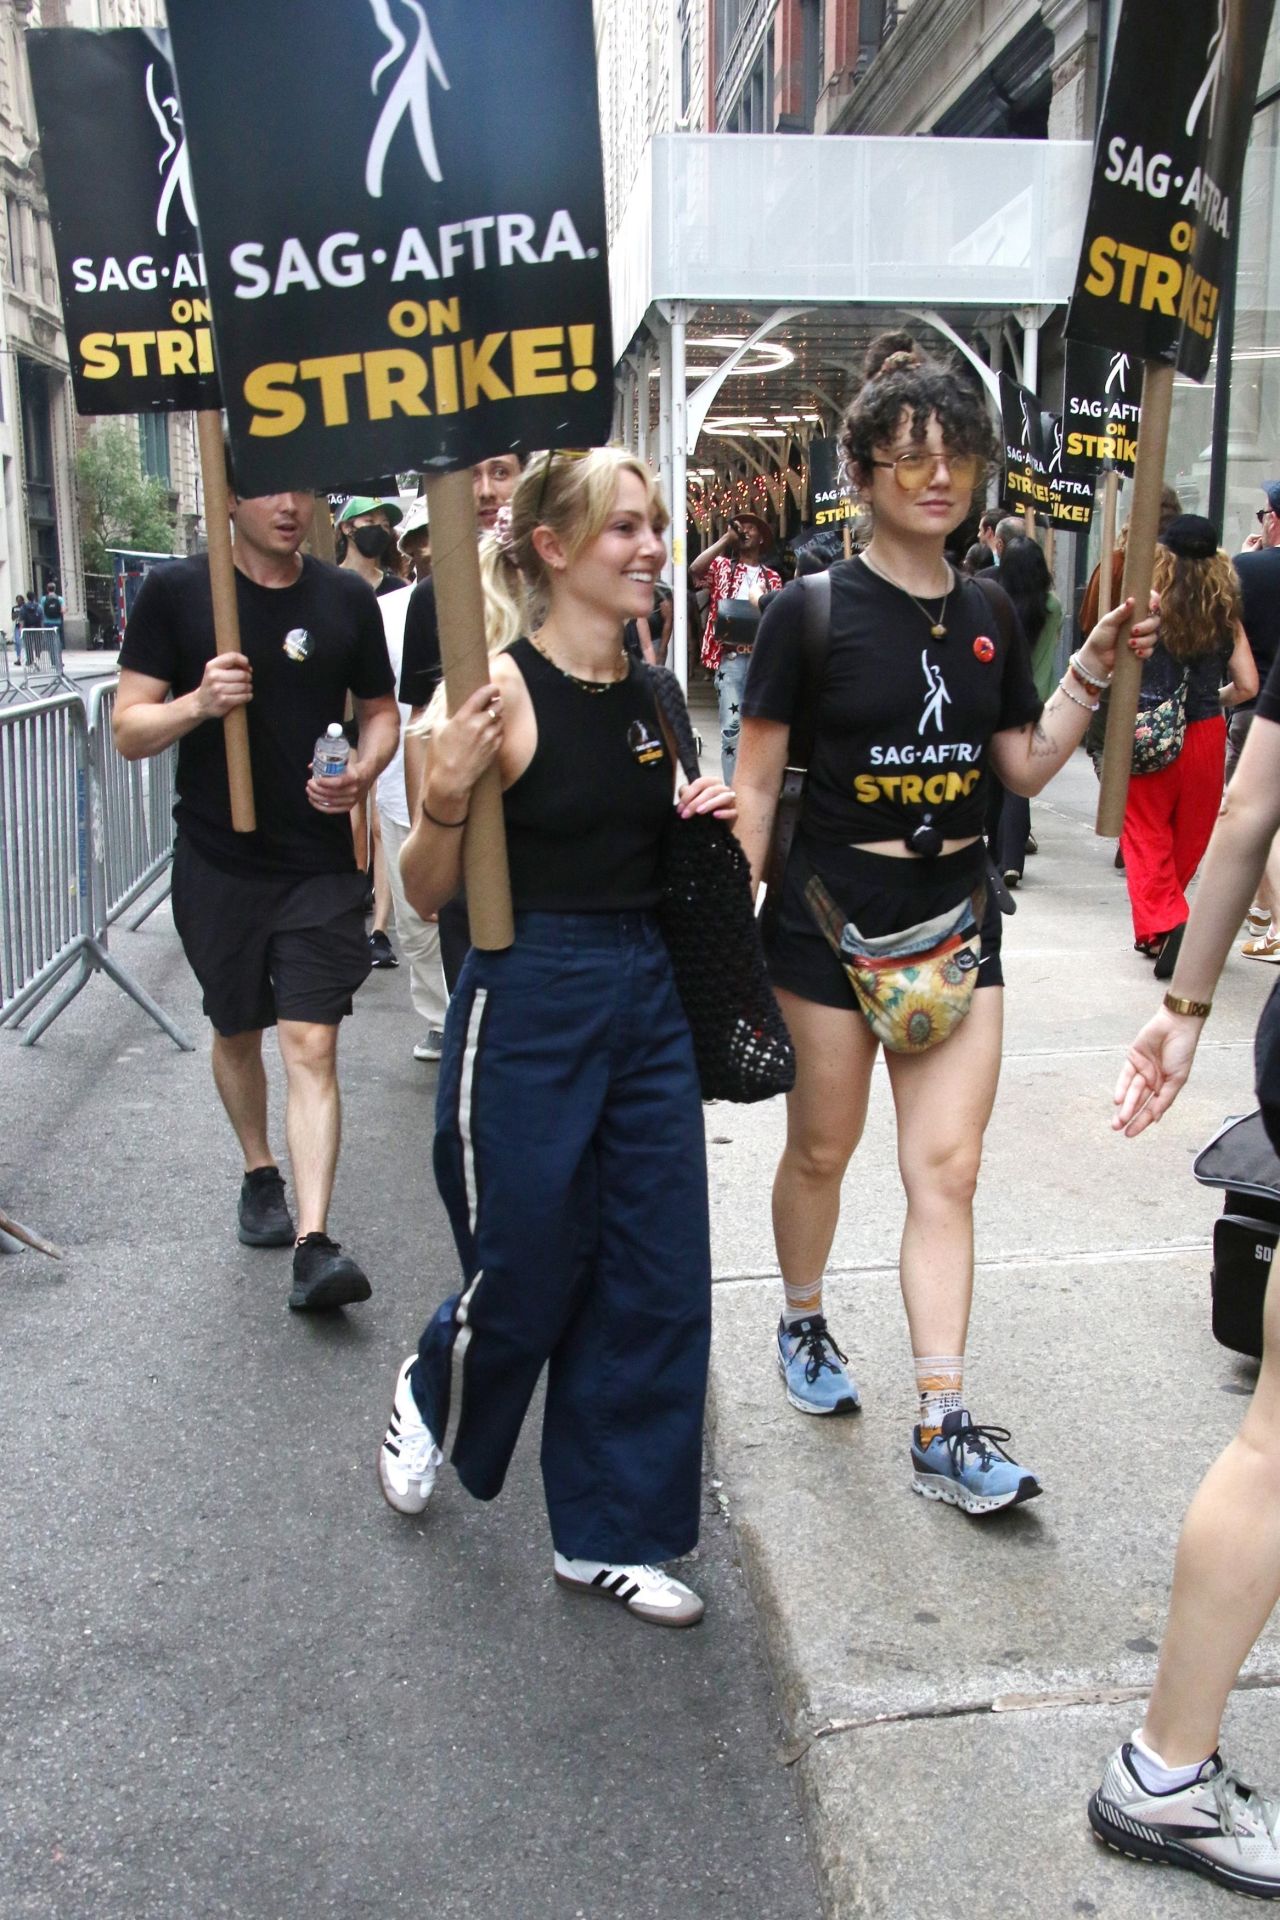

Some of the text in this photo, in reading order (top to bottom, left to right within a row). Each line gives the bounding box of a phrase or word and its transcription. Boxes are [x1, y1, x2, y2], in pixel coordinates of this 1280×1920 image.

[388, 296, 461, 338] ON
[79, 327, 214, 380] STRI
[243, 323, 597, 437] STRIKE!
[1105, 422, 1127, 437] ON
